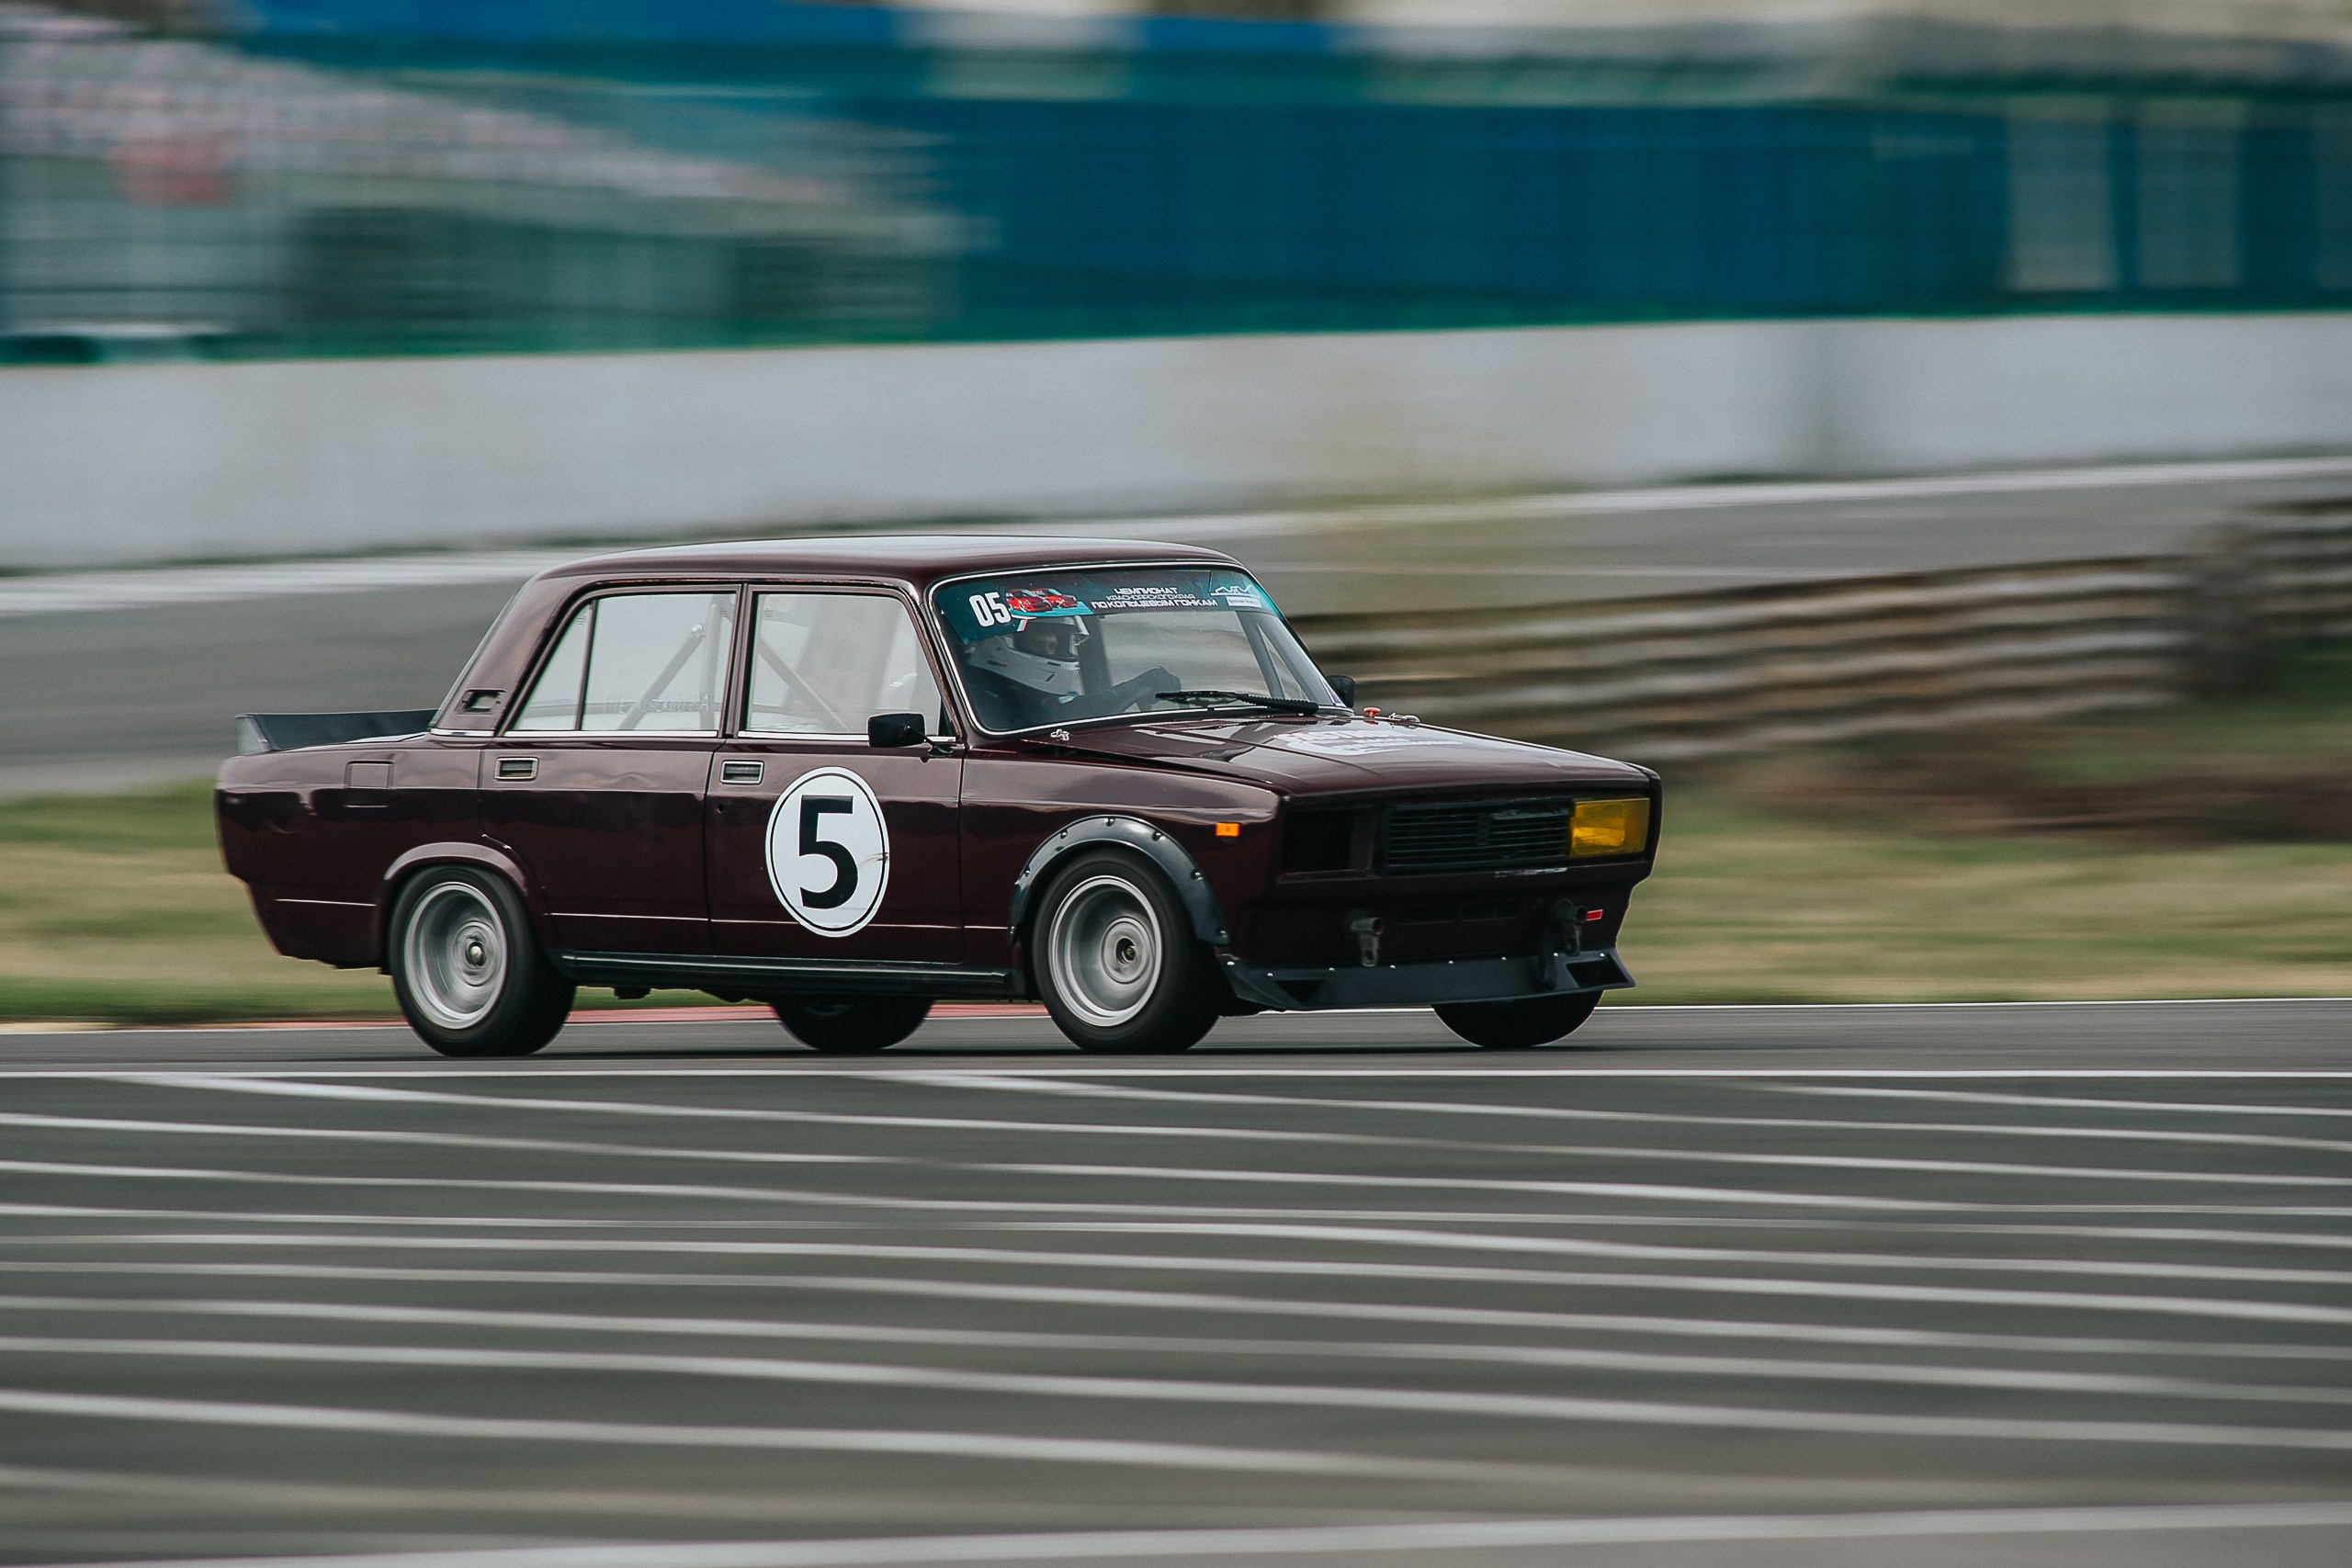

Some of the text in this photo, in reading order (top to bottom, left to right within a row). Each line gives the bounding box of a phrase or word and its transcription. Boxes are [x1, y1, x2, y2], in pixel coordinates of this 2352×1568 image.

[969, 592, 1011, 626] 05
[1091, 601, 1109, 609] ПО
[1108, 600, 1174, 608] КОЛЬЦЕВЫМ
[1174, 599, 1218, 607] ГОНКАМ
[798, 795, 858, 909] 5
